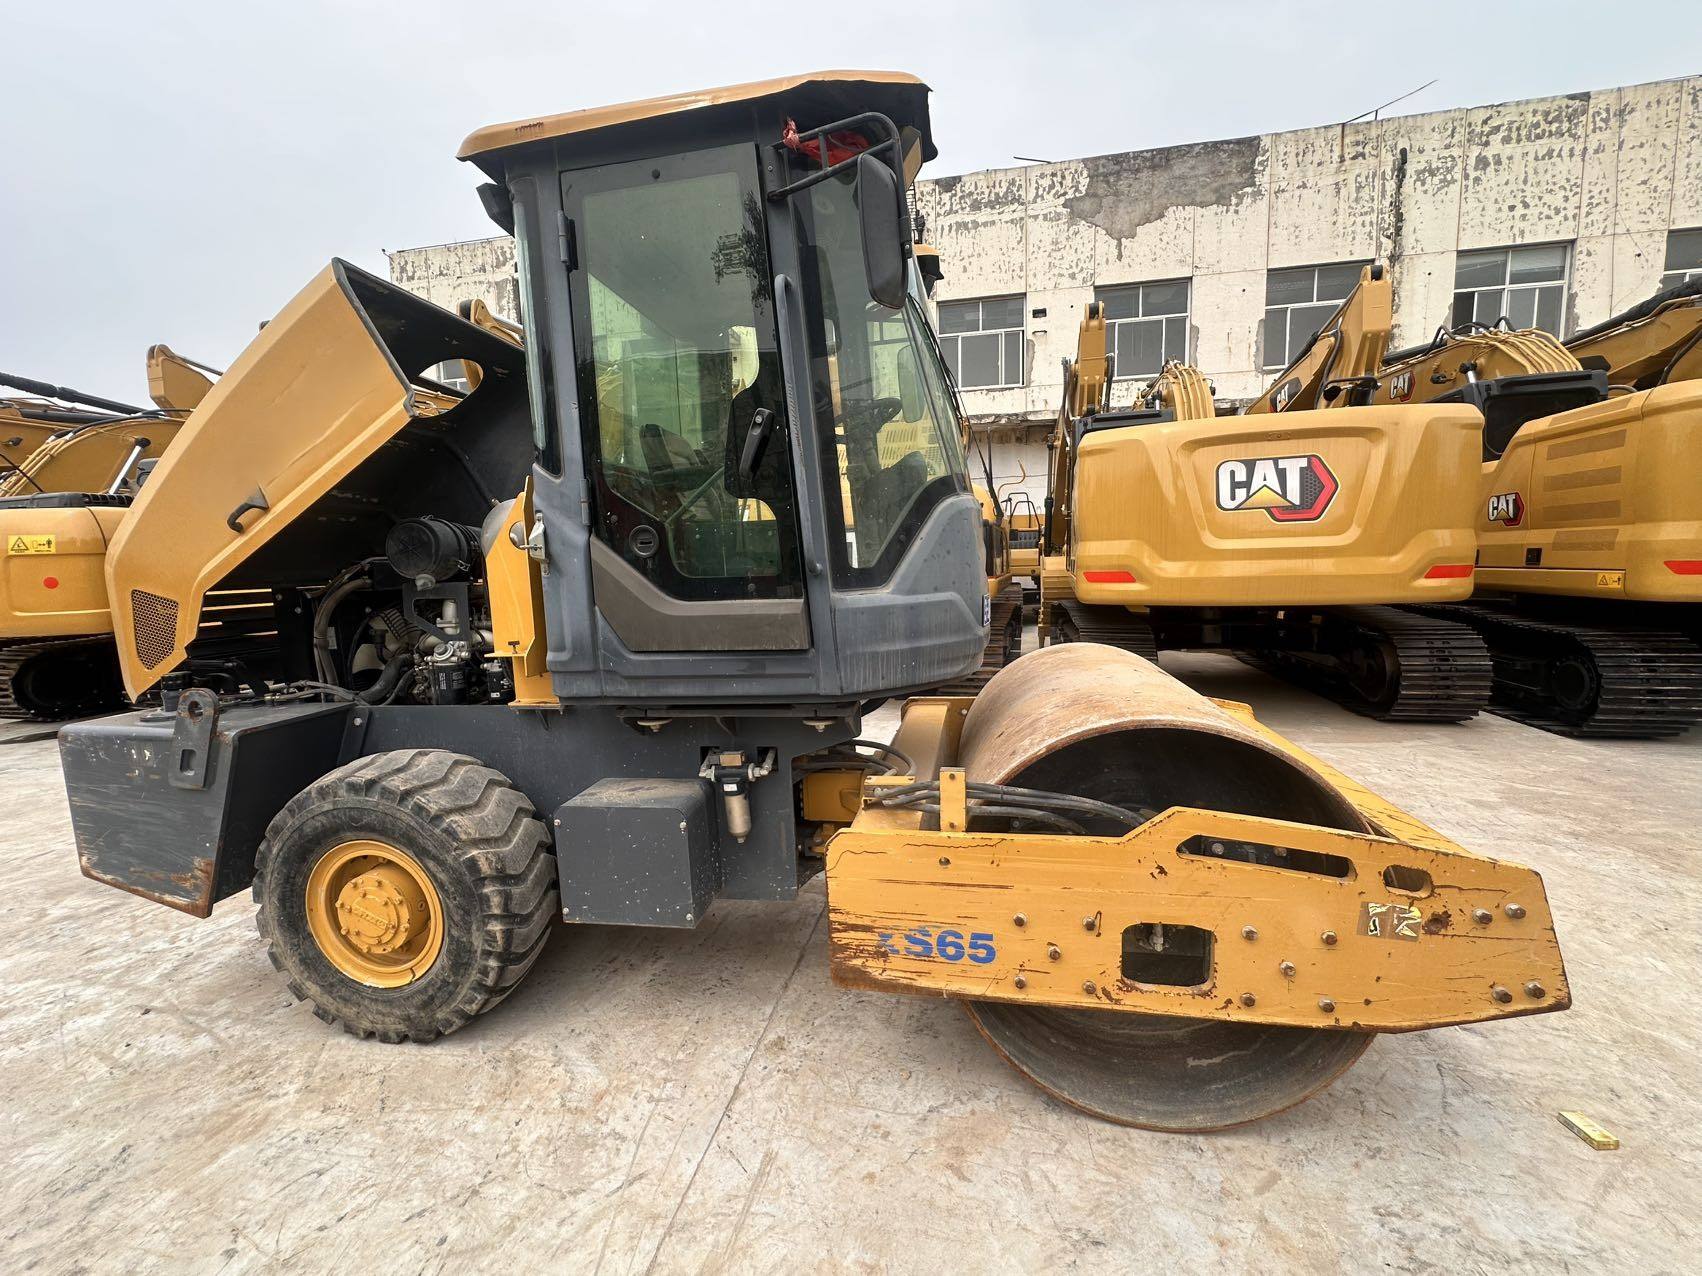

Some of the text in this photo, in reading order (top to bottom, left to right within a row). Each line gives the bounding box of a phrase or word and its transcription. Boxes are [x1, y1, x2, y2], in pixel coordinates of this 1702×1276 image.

[1390, 371, 1411, 399] CAT
[1218, 457, 1308, 509] CAT
[1488, 493, 1516, 520] CAT
